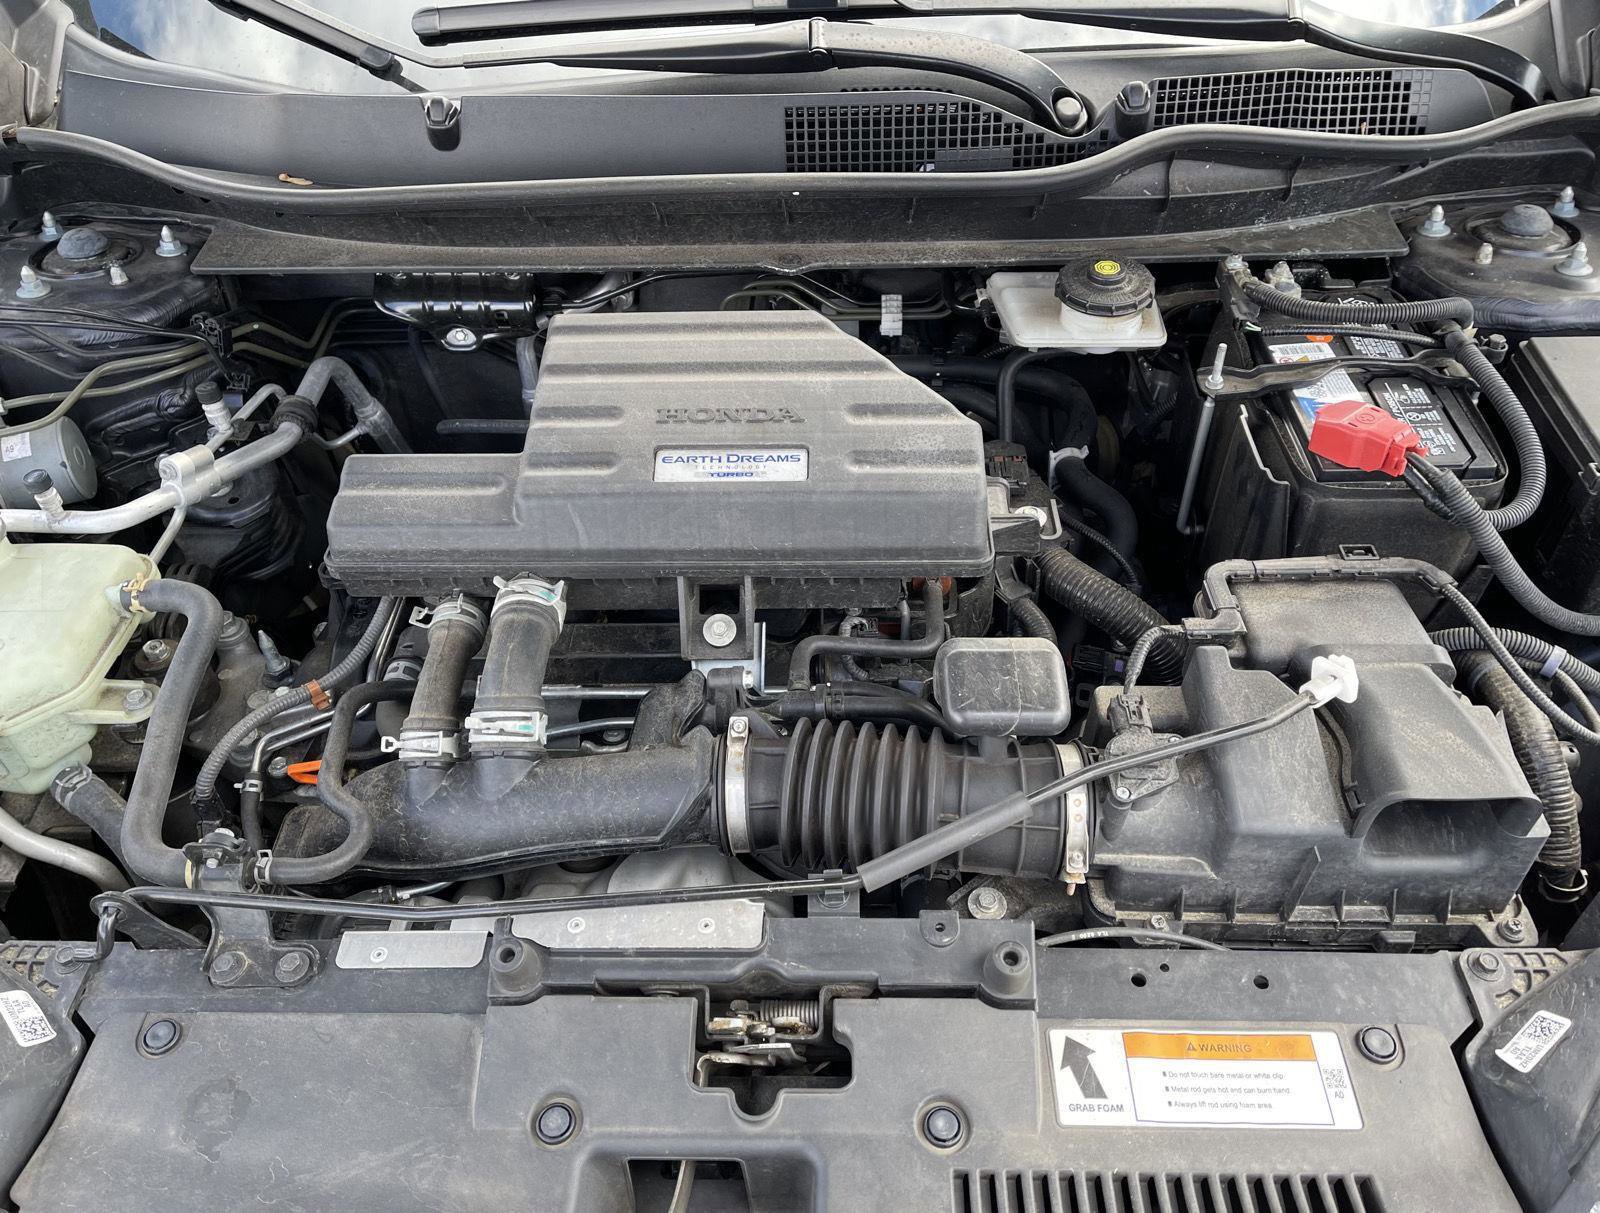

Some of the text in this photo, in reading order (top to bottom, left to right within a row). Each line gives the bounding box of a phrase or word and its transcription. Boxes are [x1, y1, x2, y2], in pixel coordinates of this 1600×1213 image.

[656, 408, 807, 424] HONDA
[661, 453, 801, 463] EARTH DREAMS
[1199, 1044, 1252, 1053] WARNING
[1068, 1103, 1125, 1112] GRAB FOAM
